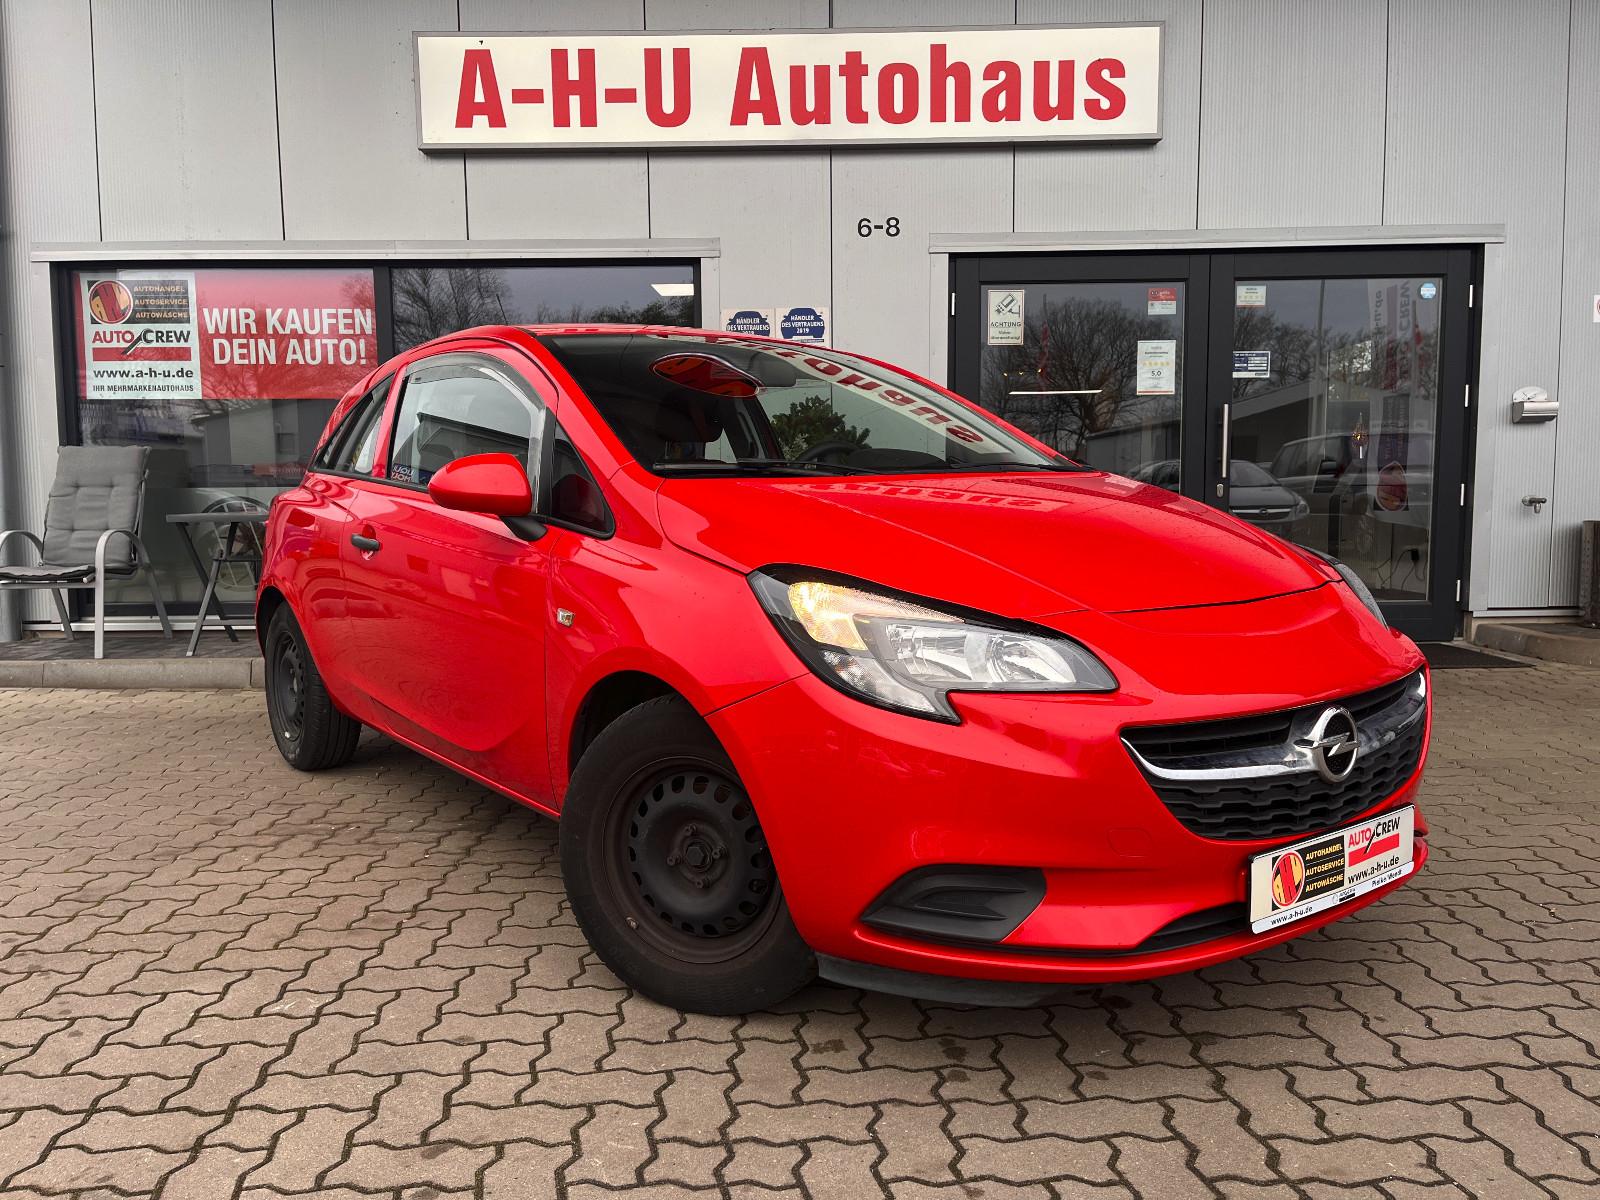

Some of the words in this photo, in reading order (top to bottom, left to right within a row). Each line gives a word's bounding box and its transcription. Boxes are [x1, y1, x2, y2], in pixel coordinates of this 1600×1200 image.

[455, 47, 692, 129] A-H-U
[730, 43, 1127, 126] Autohaus
[857, 216, 901, 238] 6-8
[134, 298, 188, 306] AUTOSERVICE
[203, 307, 257, 334] WIR
[266, 307, 372, 335] KAUFEN
[736, 316, 760, 325] HÄNDLER
[737, 324, 770, 332] VERTRAUENS
[92, 330, 135, 344] AUTO
[142, 328, 191, 344] CREW
[213, 338, 277, 365] DEIN
[285, 338, 367, 365] AUTO!
[93, 368, 194, 379] www.a-h-u.de
[93, 384, 105, 392] IHR
[107, 384, 194, 392] MEHRMARKENAUTOHAUS
[1348, 827, 1371, 848] AUTO
[1375, 816, 1400, 837] CREW
[1305, 843, 1343, 861] AUTOHANDEL
[1305, 859, 1344, 877] AUTOSERVICE
[1348, 855, 1400, 884] www.a-h-u.de
[1271, 905, 1313, 926] www.a-h-u.de
